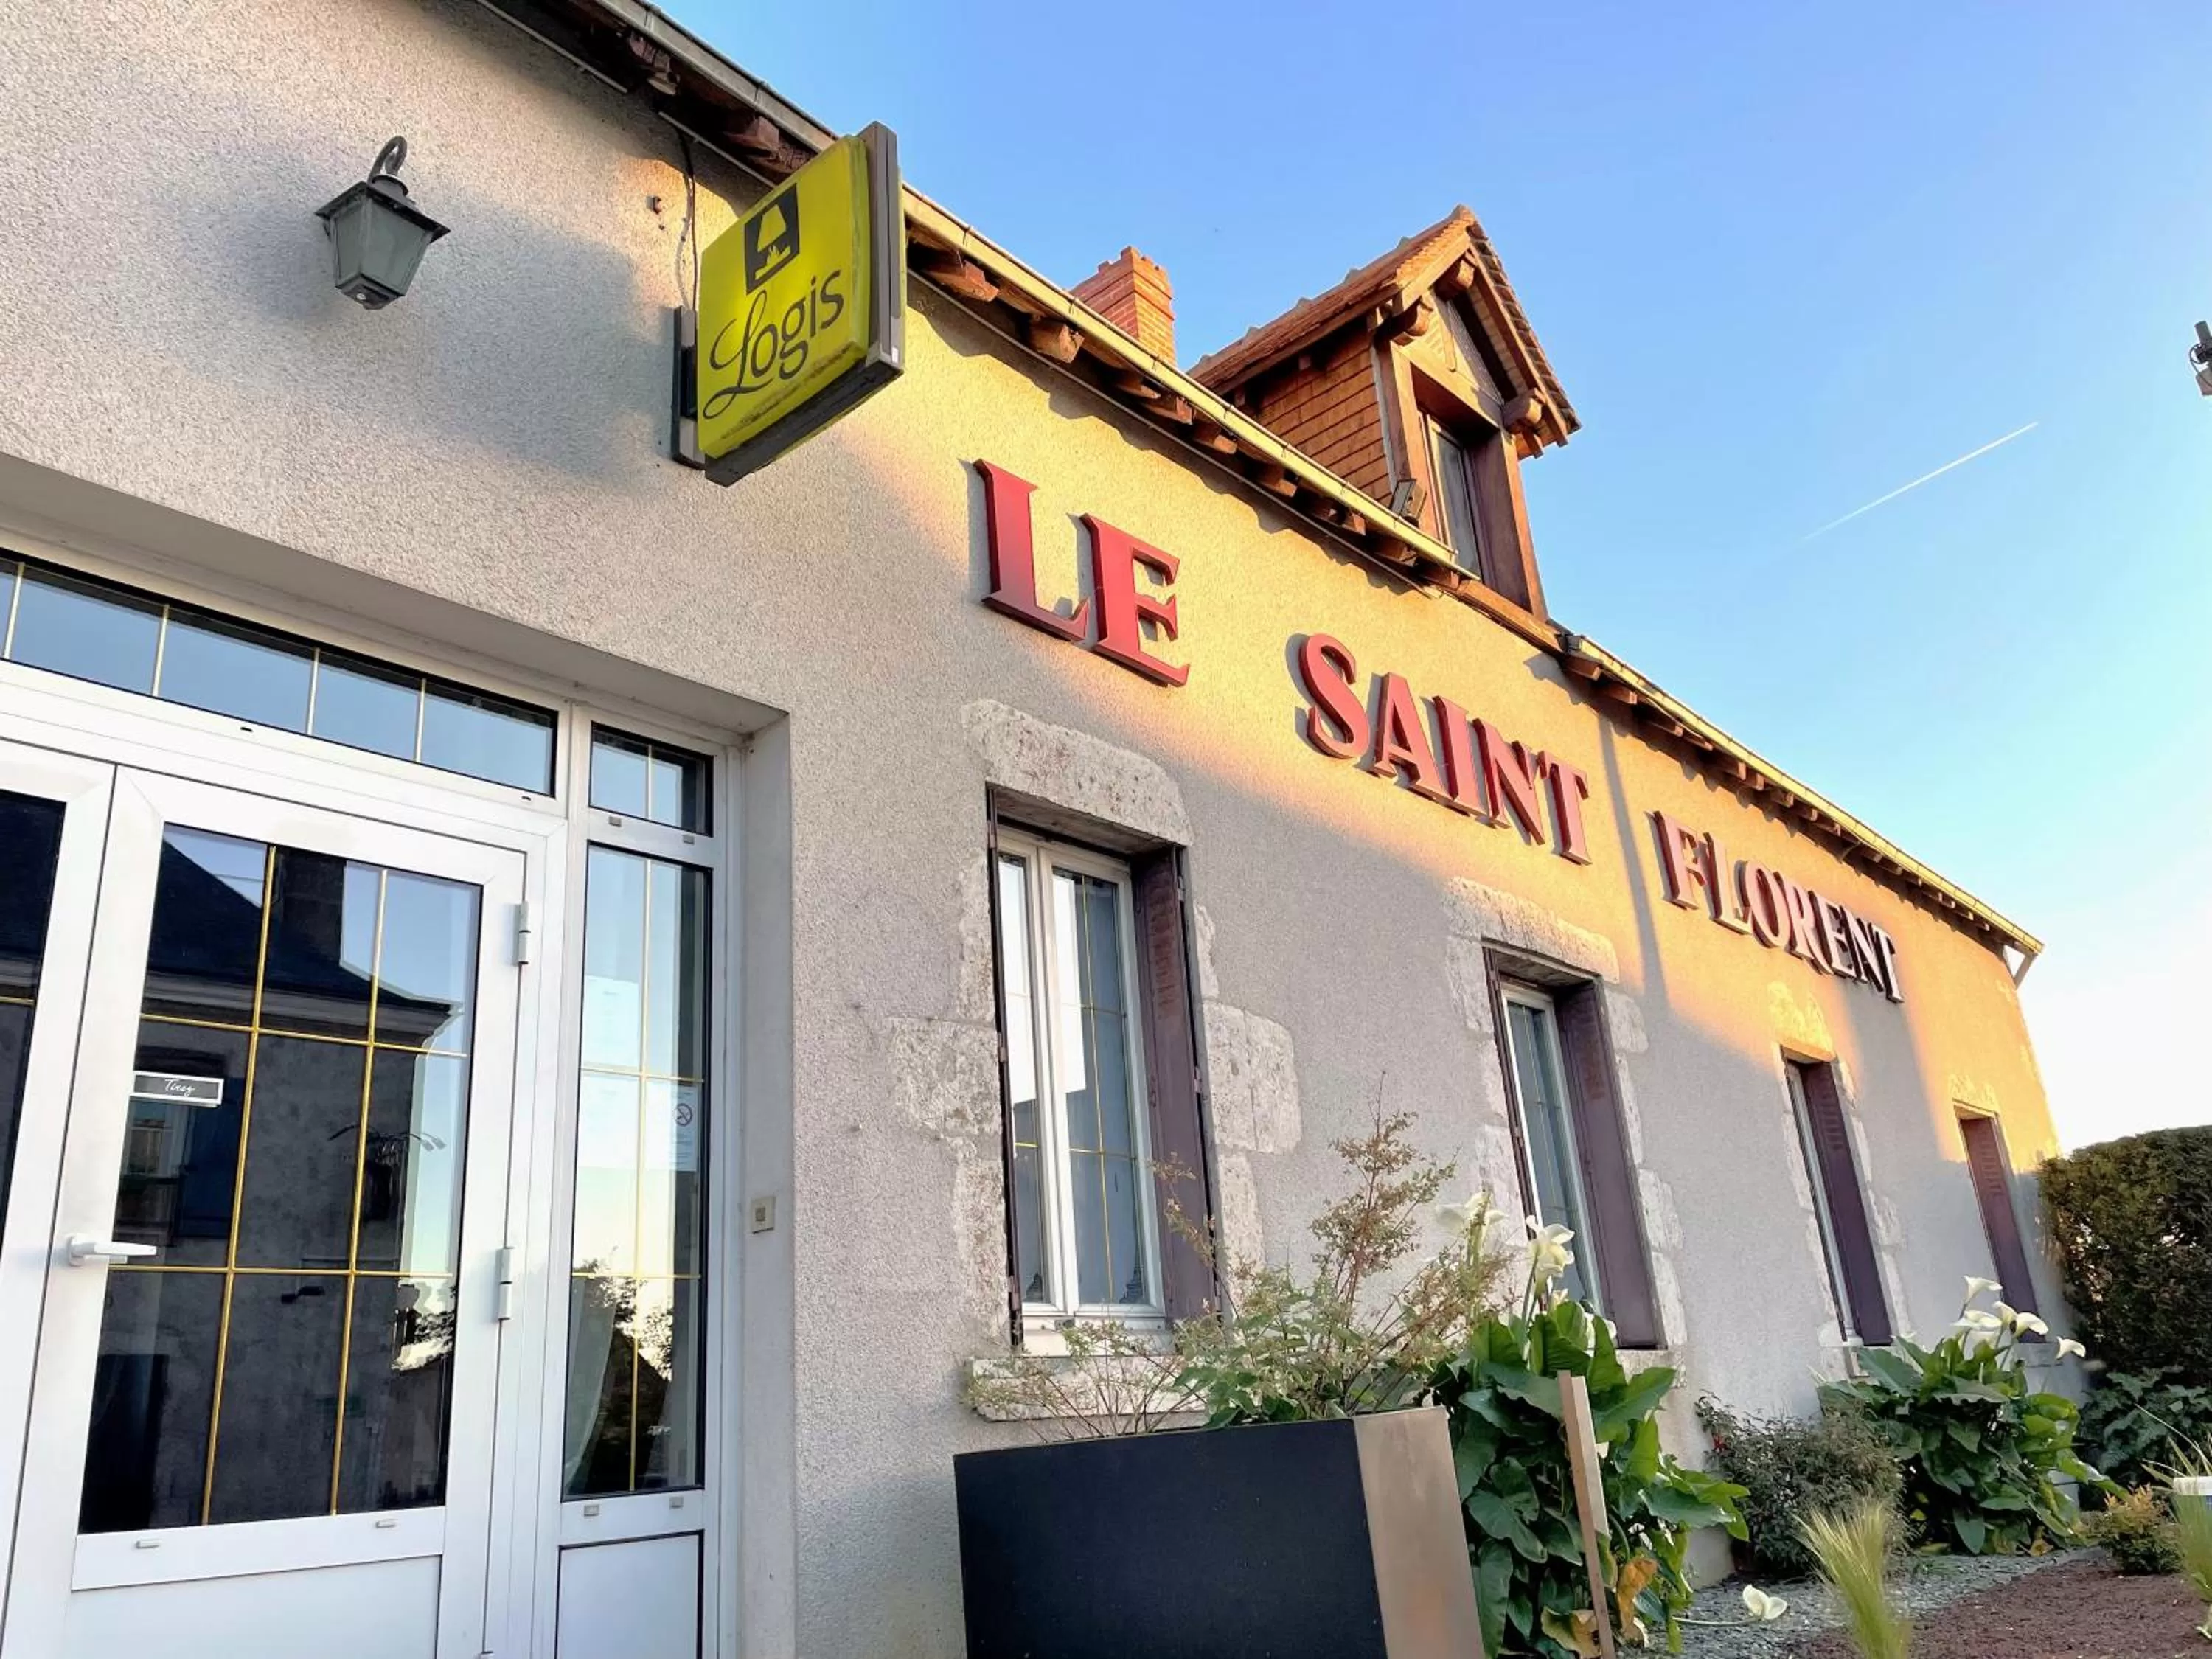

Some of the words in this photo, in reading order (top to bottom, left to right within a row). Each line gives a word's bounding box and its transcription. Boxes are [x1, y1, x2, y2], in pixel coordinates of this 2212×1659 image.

[703, 268, 845, 420] Logis
[973, 458, 1191, 687] LE
[1298, 633, 1593, 866] SAINT
[1652, 810, 1905, 1004] FLORENT
